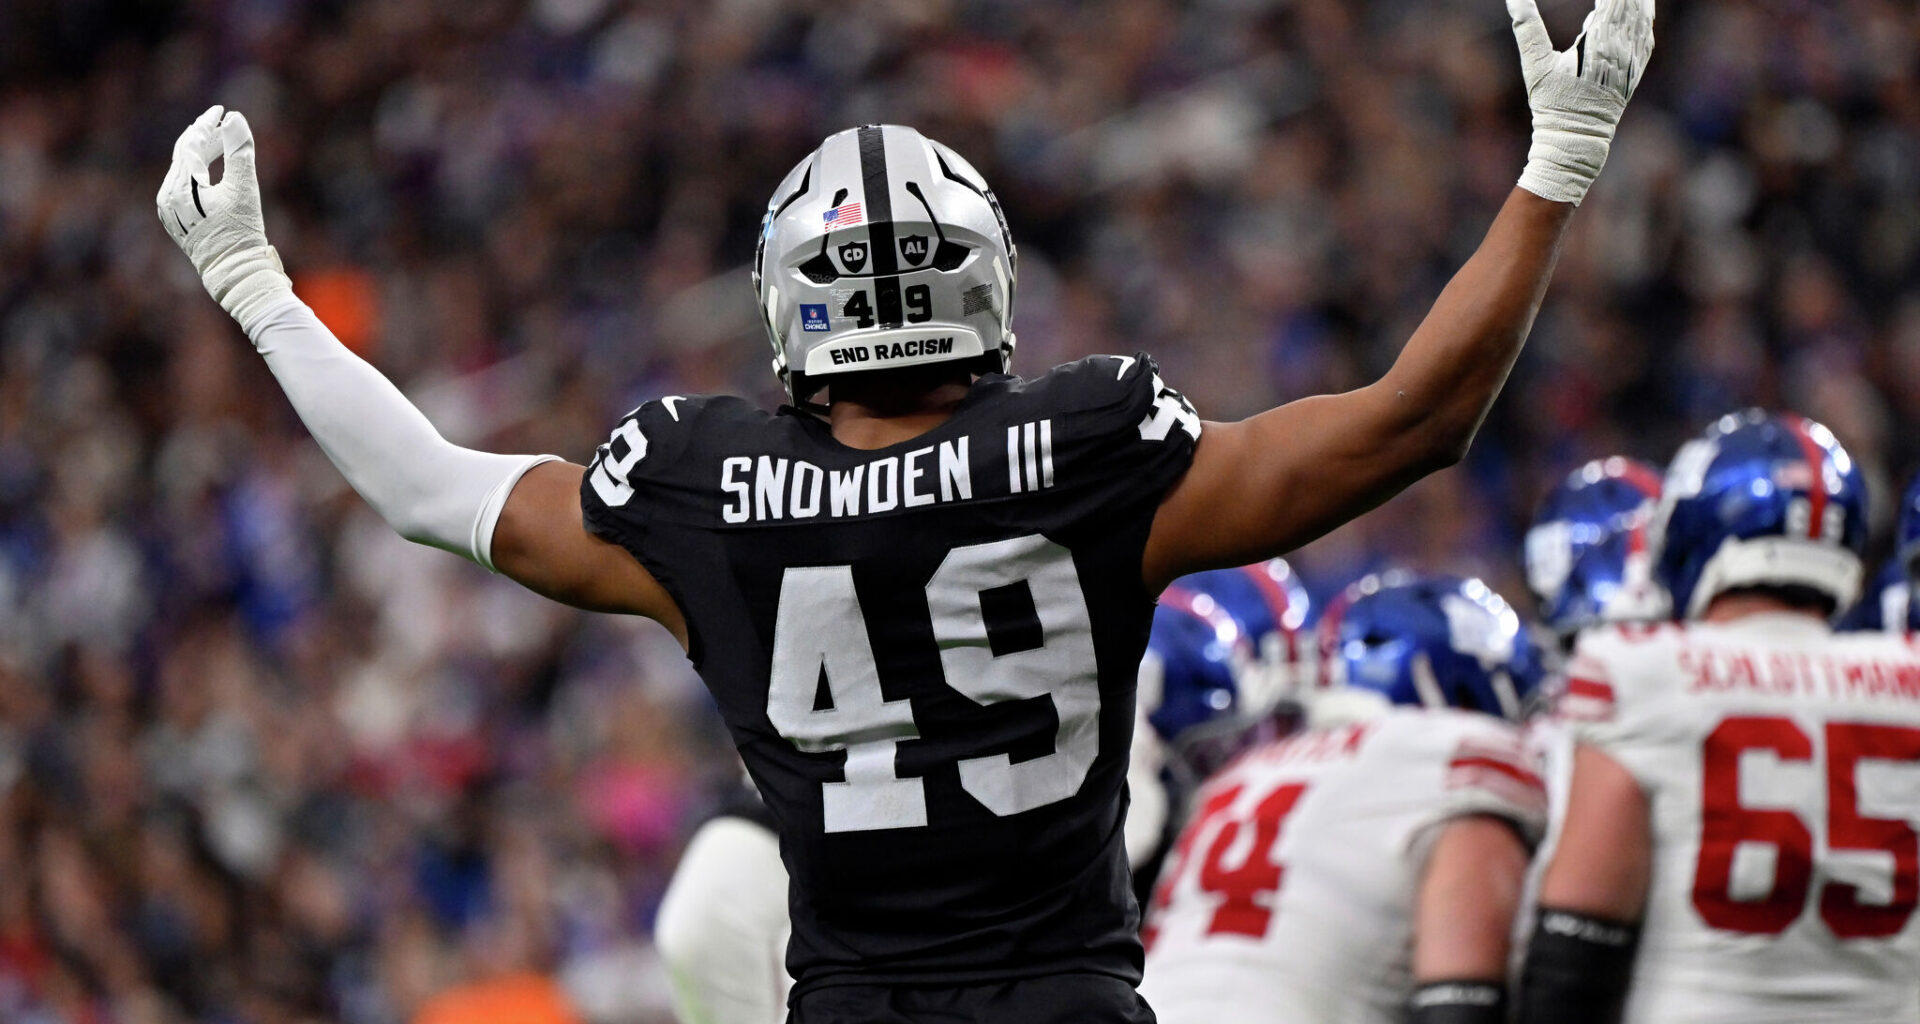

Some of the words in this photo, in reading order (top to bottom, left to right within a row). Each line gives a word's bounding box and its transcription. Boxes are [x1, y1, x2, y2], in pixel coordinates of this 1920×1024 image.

[843, 247, 864, 262] CD
[904, 240, 926, 255] AL
[829, 346, 870, 366] END
[874, 337, 954, 361] RACISM
[588, 418, 649, 507] 9
[721, 436, 972, 523] SNOWDEN
[1007, 419, 1054, 493] III
[768, 533, 1100, 832] 49
[1692, 715, 1920, 940] 65
